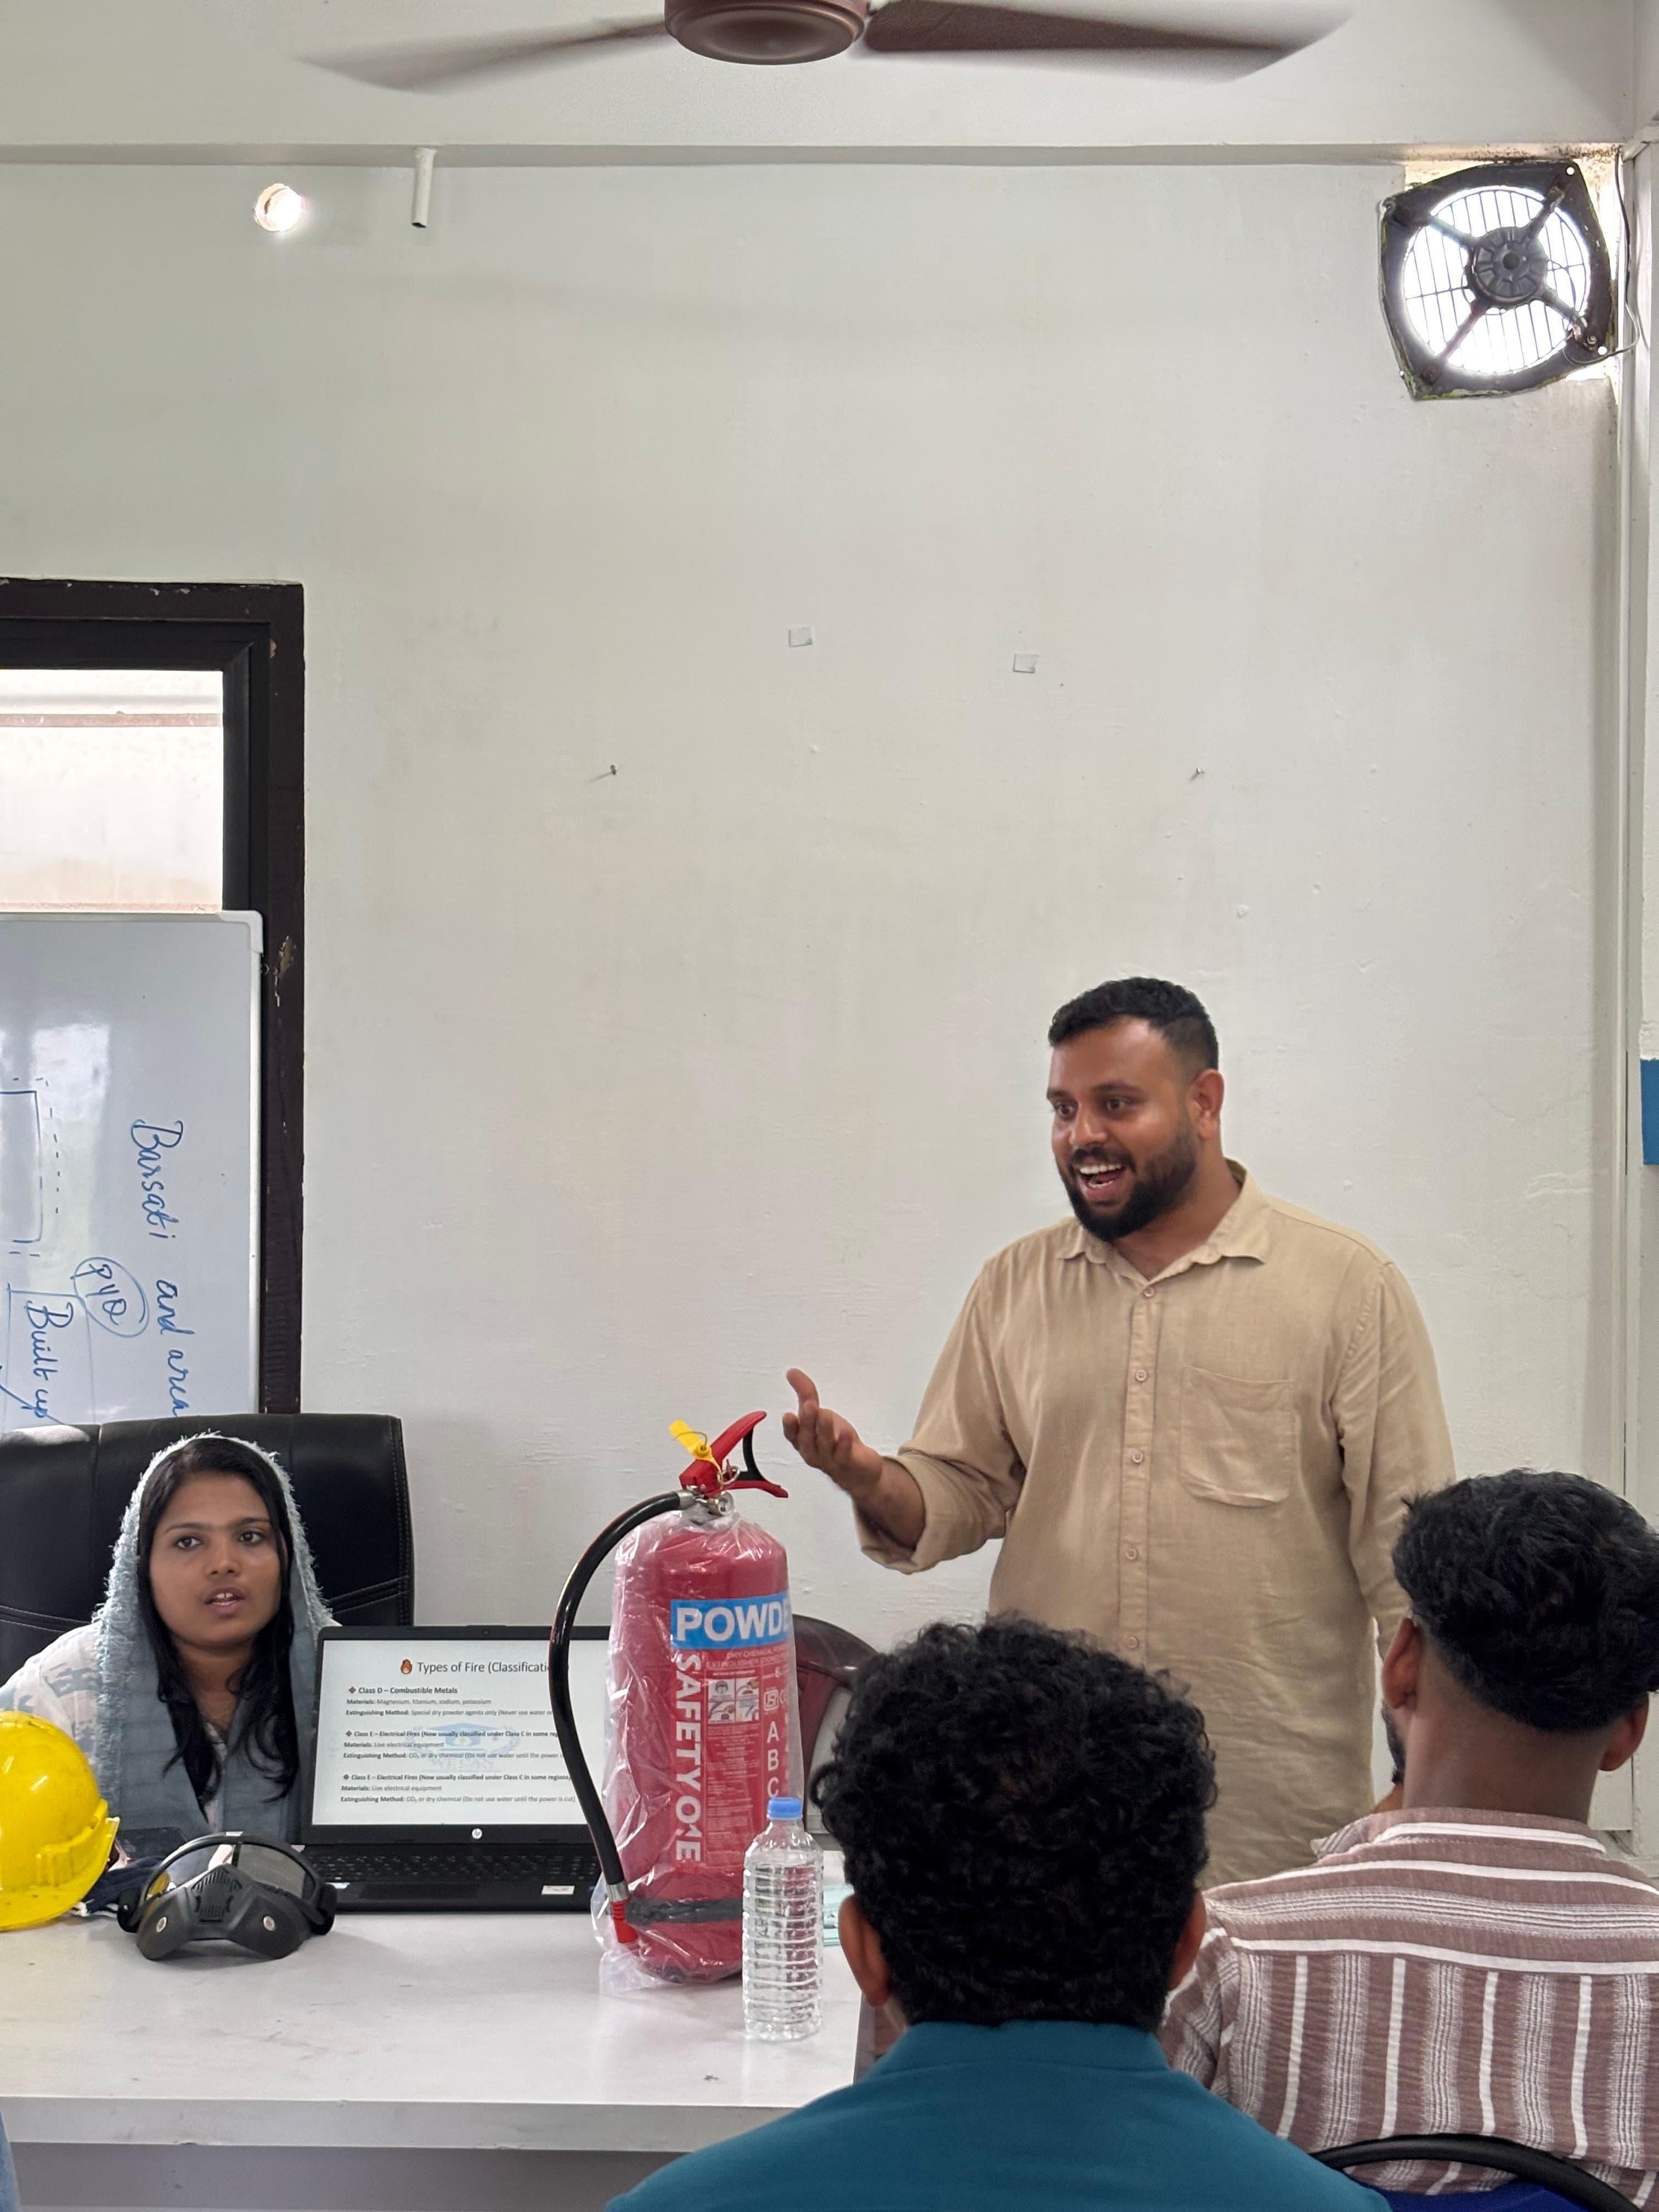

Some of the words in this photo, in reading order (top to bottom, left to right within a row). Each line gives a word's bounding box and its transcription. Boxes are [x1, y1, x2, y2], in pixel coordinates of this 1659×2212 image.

[130, 1119, 184, 1239] Barsati
[156, 1279, 195, 1335] and
[24, 1300, 74, 1381] Built
[21, 1389, 48, 1418] up
[417, 1662, 448, 1674] Types
[450, 1661, 463, 1672] of
[466, 1662, 485, 1672] Fire
[488, 1661, 549, 1674] (Classificati
[675, 1653, 702, 1791] SAFETY
[766, 1720, 780, 1743] A
[768, 1748, 780, 1771] B
[767, 1776, 779, 1798] C
